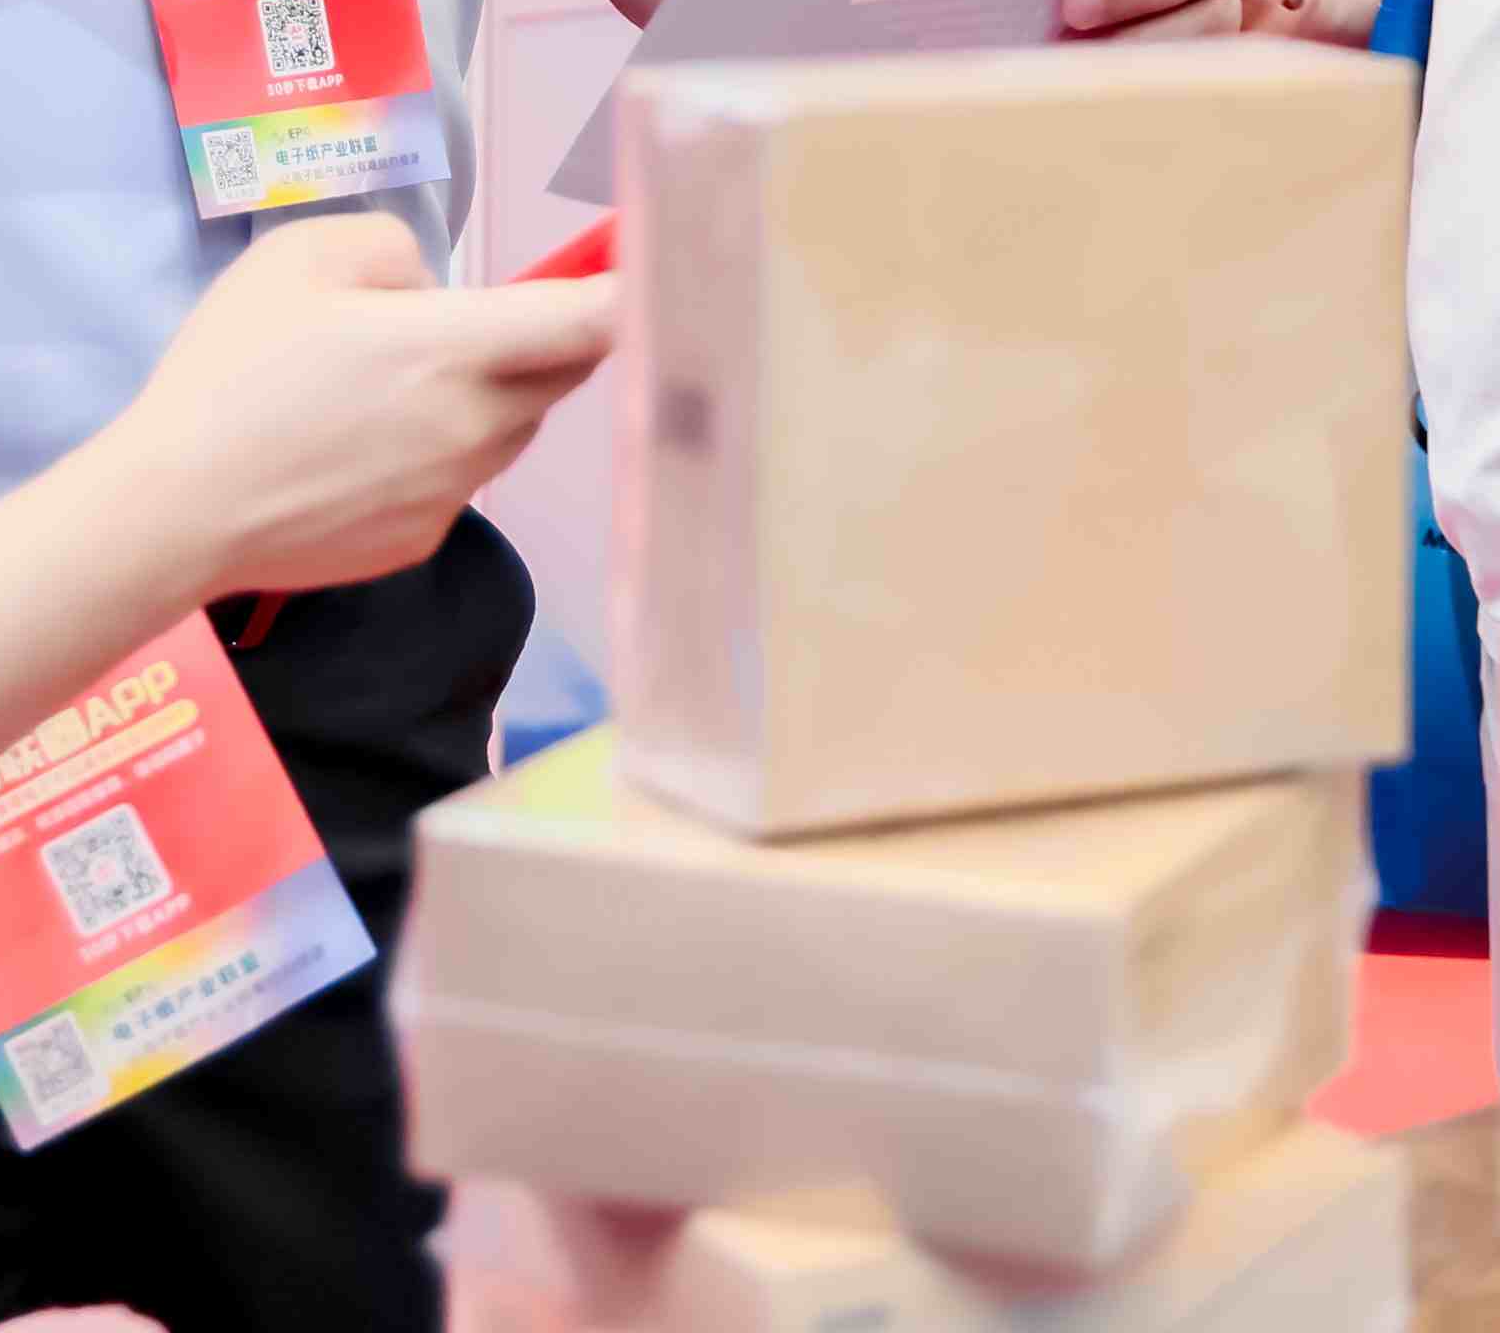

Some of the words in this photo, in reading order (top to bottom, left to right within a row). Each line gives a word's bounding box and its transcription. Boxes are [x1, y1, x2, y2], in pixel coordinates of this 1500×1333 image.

[276, 135, 378, 166] 电子纸产业联盟
